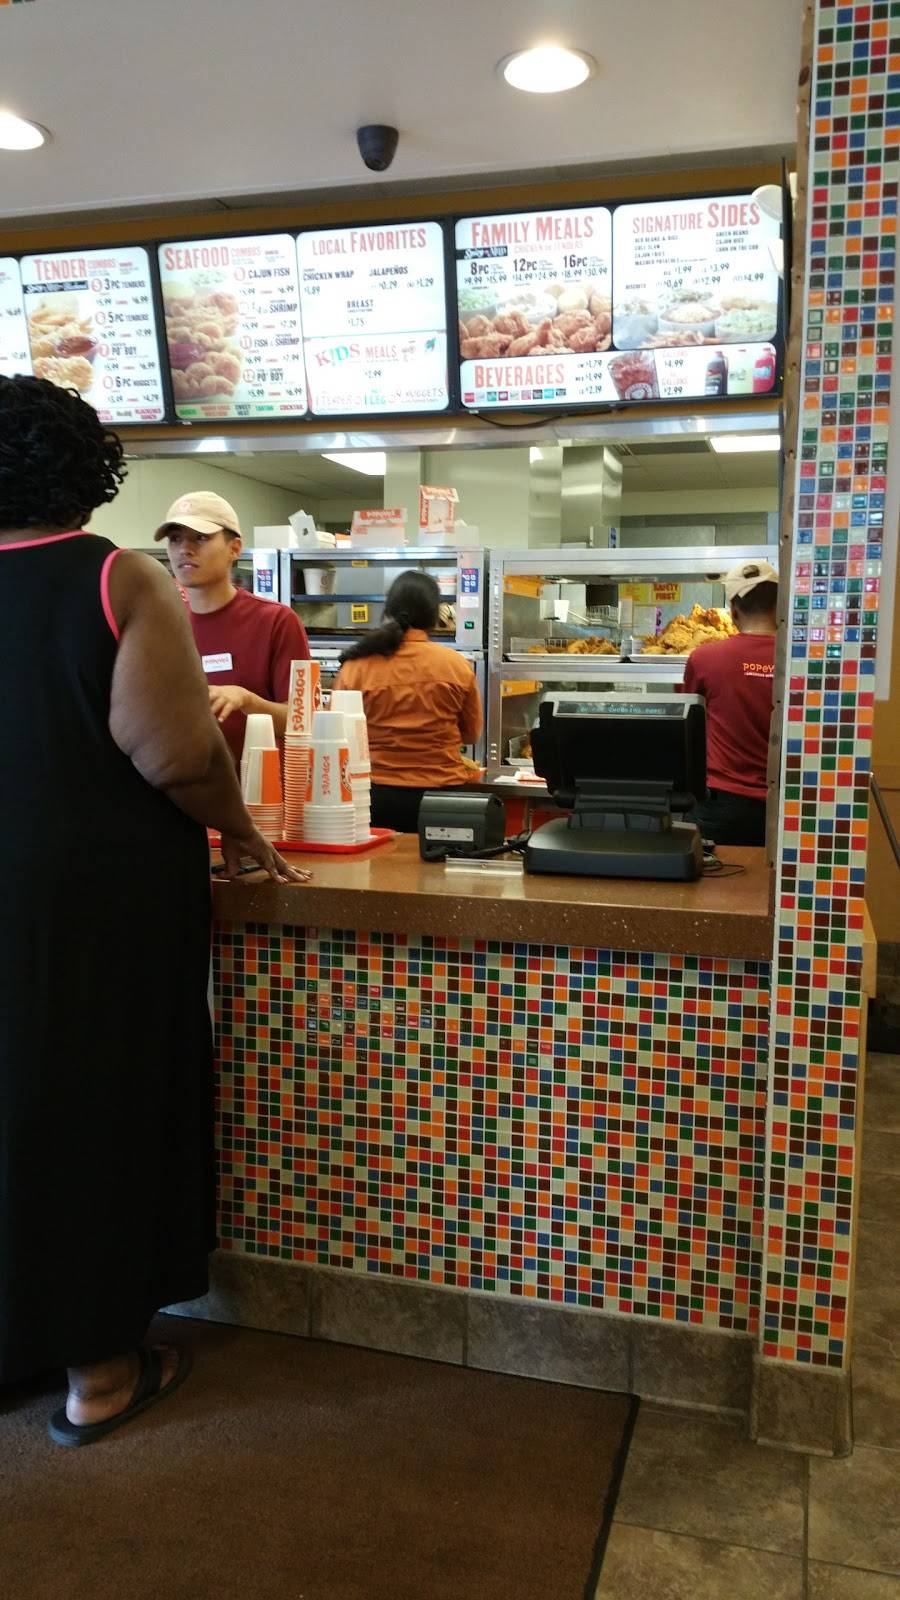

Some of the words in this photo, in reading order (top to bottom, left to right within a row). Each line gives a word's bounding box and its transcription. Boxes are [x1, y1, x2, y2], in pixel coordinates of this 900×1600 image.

[632, 212, 704, 234] SIGNATURE
[707, 202, 761, 228] SIDES
[471, 220, 530, 247] FAMILY
[536, 215, 594, 242] MEALS
[312, 238, 347, 256] LOCAL
[350, 228, 427, 253] FAVORITES
[163, 246, 230, 271] SEAFOOD
[33, 258, 88, 281] TENDER
[248, 268, 273, 280] CAJUN
[273, 266, 291, 278] FISH
[303, 271, 334, 281] CHICKEN
[334, 269, 355, 280] WRAP
[368, 264, 409, 277] JALAPEÑOS
[104, 277, 111, 292] 3
[269, 302, 298, 314] SHRIMP
[275, 336, 300, 347] SHRIMP
[365, 344, 398, 360] MEALS
[473, 362, 566, 389] BEVERAGES
[742, 662, 776, 673] POPeY
